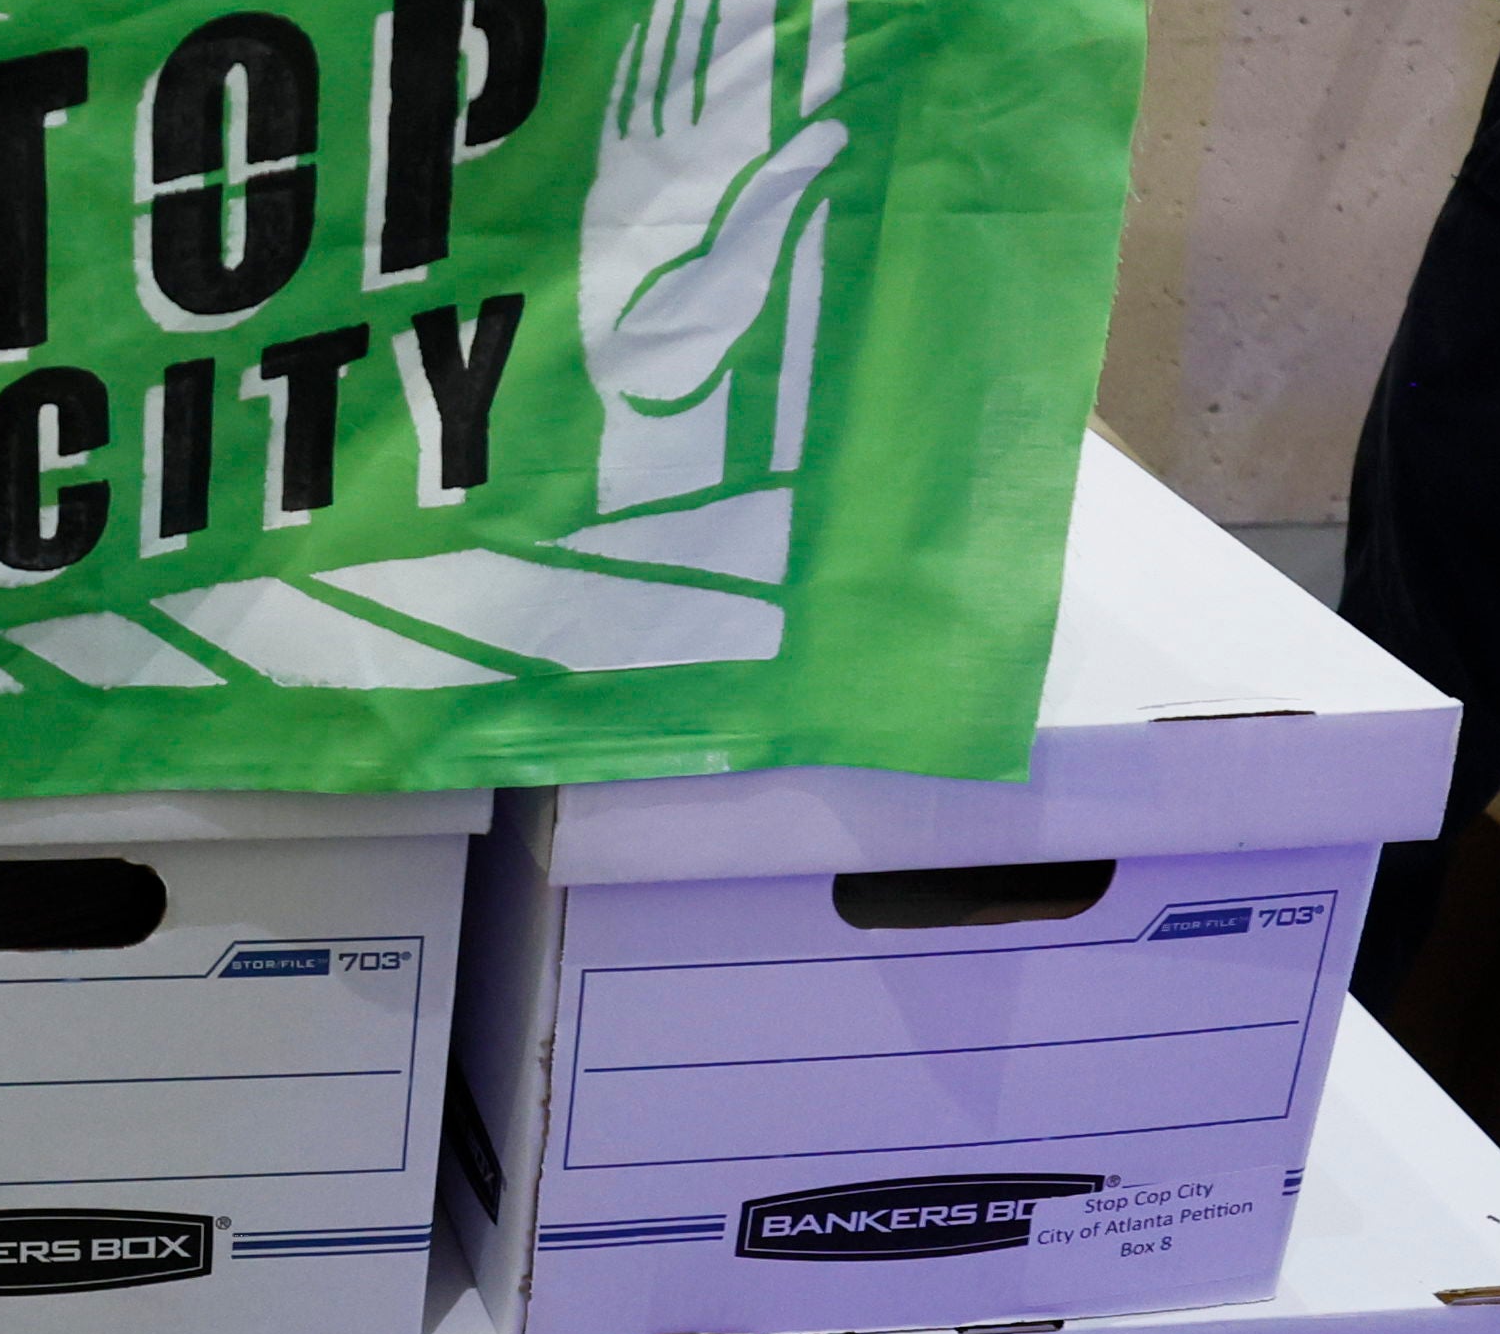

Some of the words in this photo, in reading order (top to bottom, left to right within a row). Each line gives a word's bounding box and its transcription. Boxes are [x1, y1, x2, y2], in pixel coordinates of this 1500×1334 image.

[1084, 1193, 1129, 1215] Stop
[1134, 1190, 1172, 1206] Cop
[1177, 1183, 1214, 1200] City
[760, 1204, 978, 1238] BANKERS
[986, 1200, 1036, 1223] BO
[1037, 1229, 1074, 1245] City
[1079, 1221, 1101, 1239] of
[1104, 1214, 1173, 1236] Atlanta
[1178, 1198, 1254, 1224] Petition
[91, 1235, 191, 1261] BOX
[1120, 1242, 1155, 1258] Box
[1159, 1236, 1172, 1251] 8
